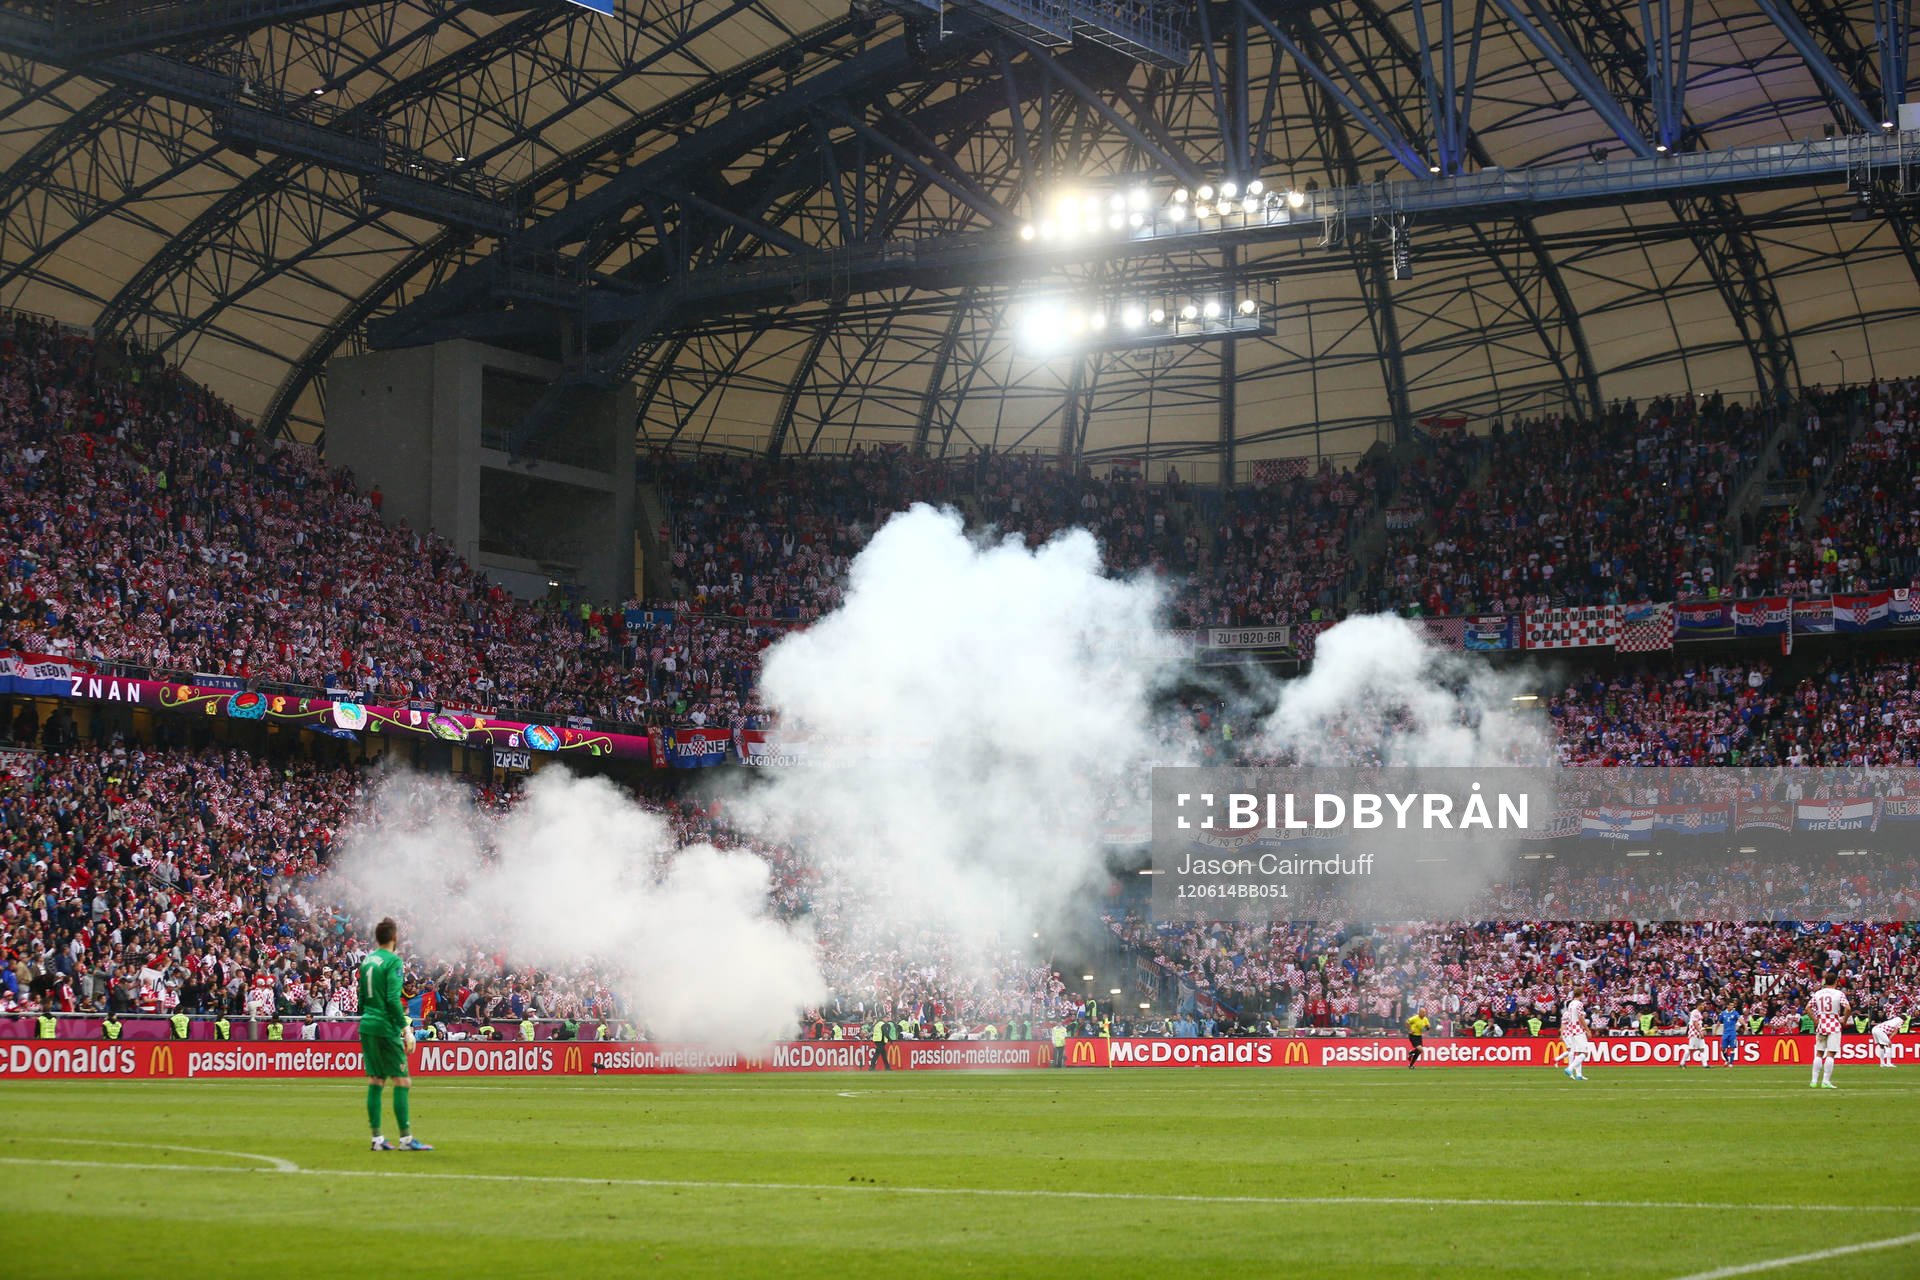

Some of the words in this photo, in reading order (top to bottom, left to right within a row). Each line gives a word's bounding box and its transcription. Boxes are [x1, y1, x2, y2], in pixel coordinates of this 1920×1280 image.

[626, 621, 672, 631] OPUZN
[1217, 633, 1231, 644] ZU
[70, 676, 141, 703] ZNAN
[196, 679, 239, 688] SLATINA
[1599, 831, 1629, 840] TROGIR
[366, 966, 374, 998] 1
[1819, 995, 1832, 1012] 13
[420, 1046, 553, 1071] McDonald's
[910, 1047, 1030, 1069] passion-meter.com
[1110, 1041, 1272, 1064] McDonald's
[1322, 1042, 1532, 1066] passionmeter.com
